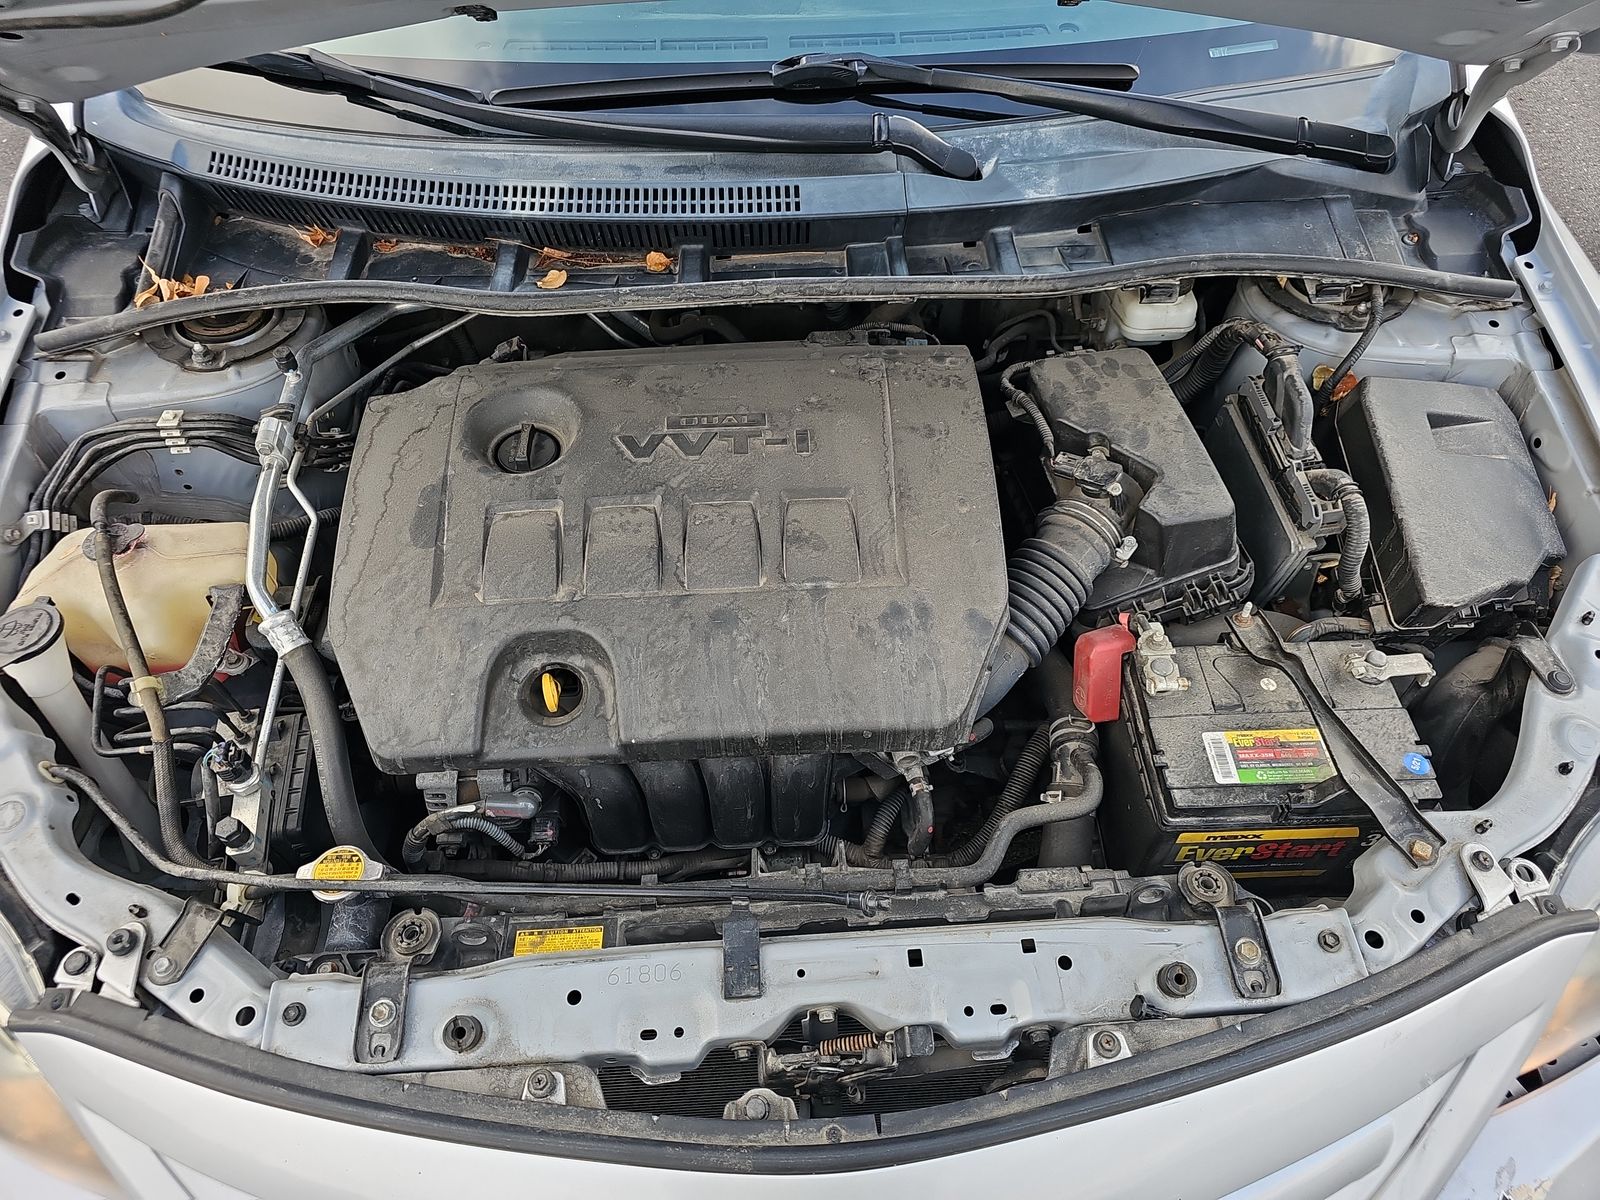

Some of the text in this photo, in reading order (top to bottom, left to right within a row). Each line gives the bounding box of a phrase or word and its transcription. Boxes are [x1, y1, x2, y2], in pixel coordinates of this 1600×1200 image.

[680, 415, 758, 426] DUAL
[1232, 736, 1282, 748] EverStart
[1410, 757, 1422, 771] 5/21
[1205, 833, 1265, 841] maxx
[1173, 840, 1347, 862] EverStart
[608, 962, 682, 985] 61806
